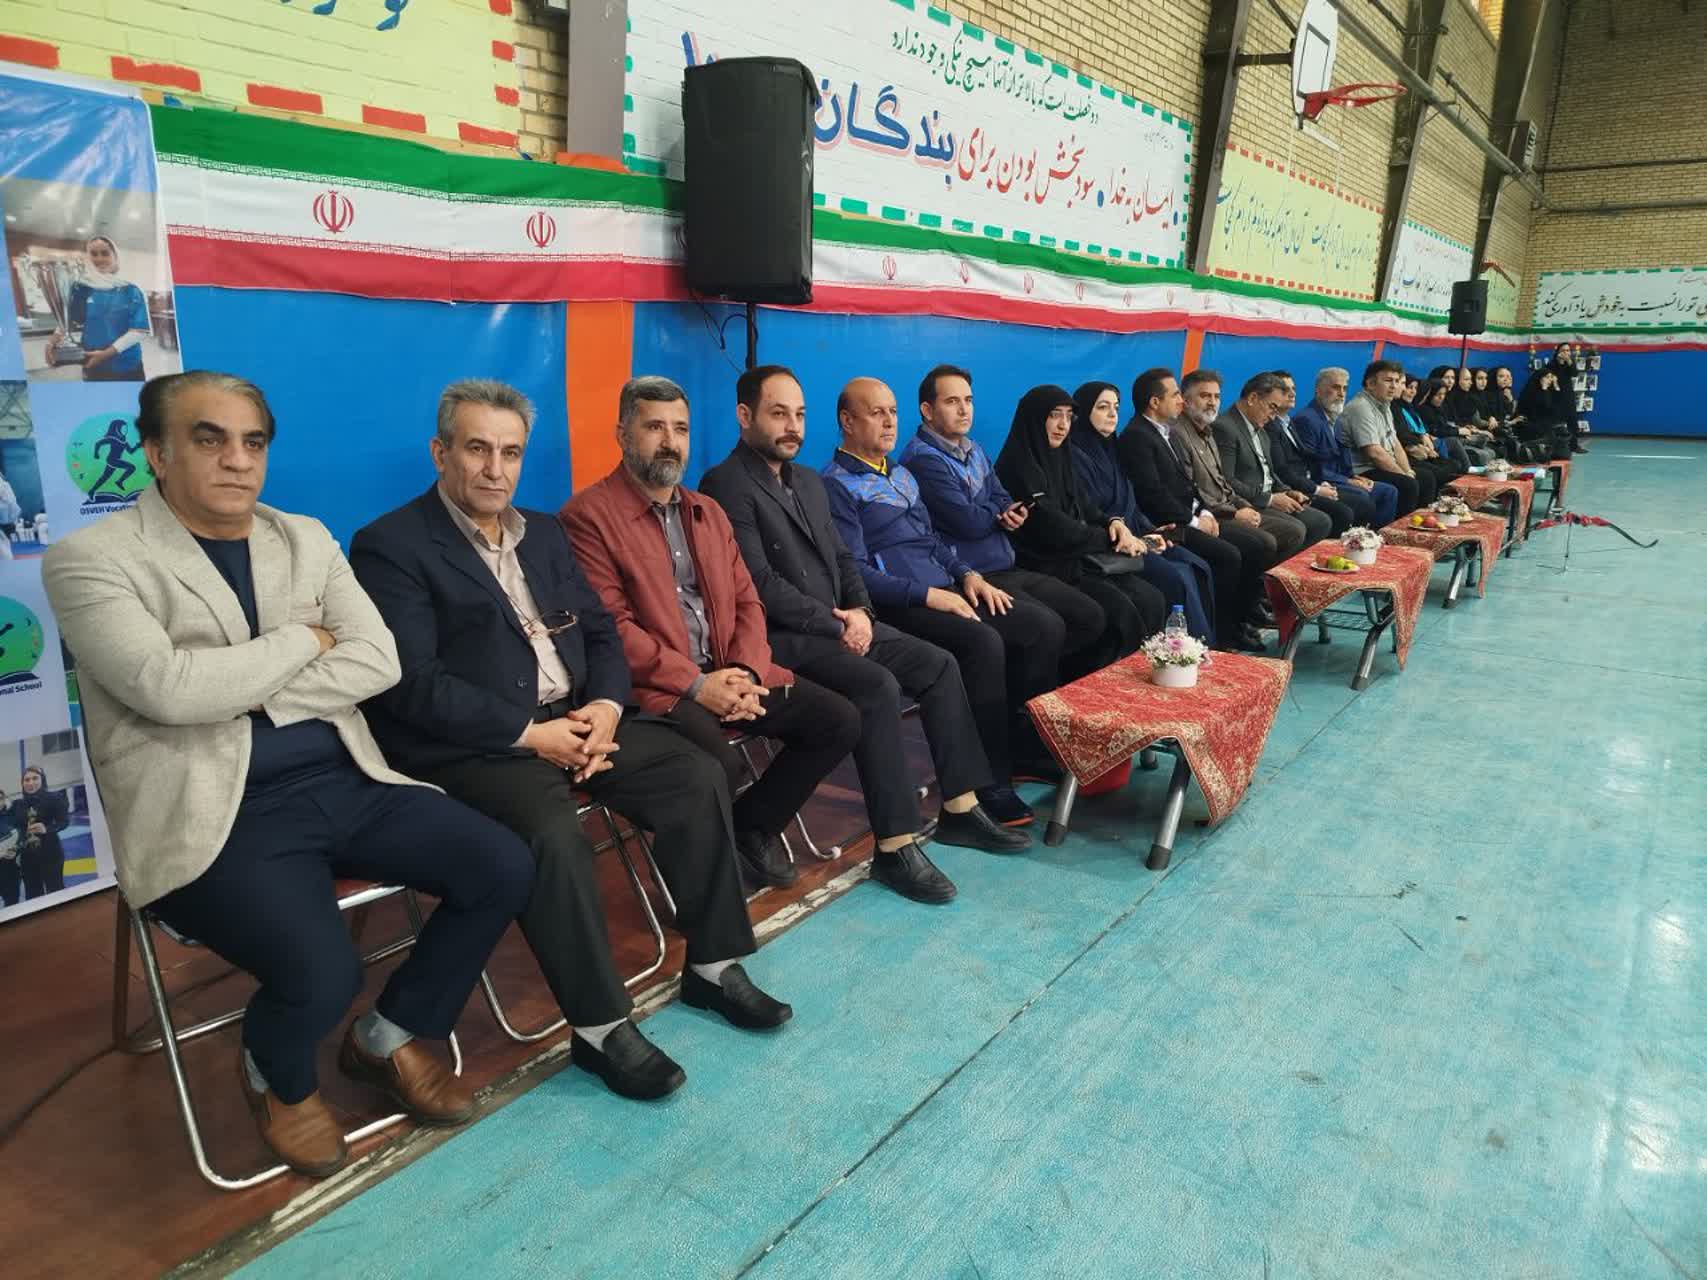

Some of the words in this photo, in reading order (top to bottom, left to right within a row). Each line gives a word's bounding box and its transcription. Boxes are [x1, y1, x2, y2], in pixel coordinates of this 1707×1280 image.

[814, 78, 955, 190] بندگان
[958, 127, 996, 190] برای
[15, 680, 42, 693] School
